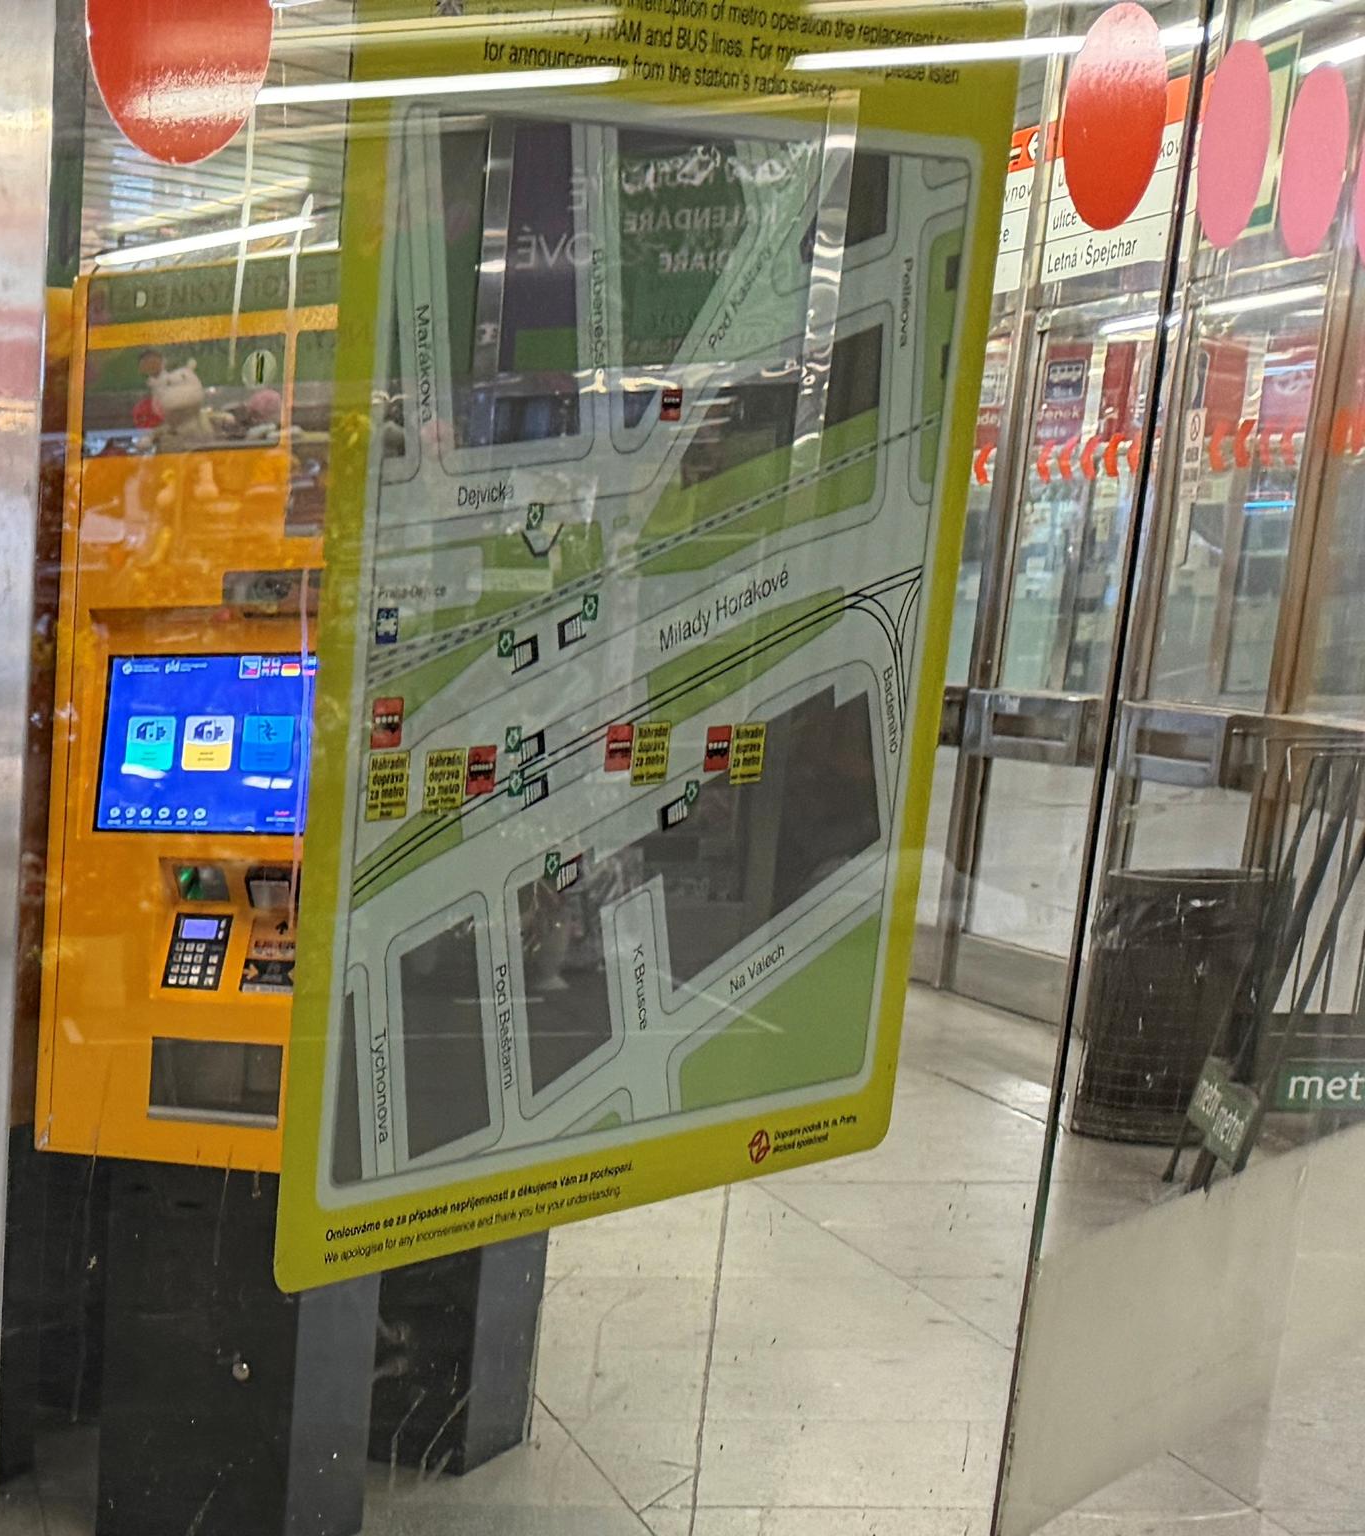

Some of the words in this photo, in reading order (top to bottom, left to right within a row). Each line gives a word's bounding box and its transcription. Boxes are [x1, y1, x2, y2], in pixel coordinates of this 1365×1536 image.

[646, 28, 671, 47] and
[676, 27, 707, 51] BUS
[751, 38, 773, 60] For
[728, 6, 766, 26] metro
[771, 13, 833, 37] operation
[484, 38, 504, 61] for
[632, 54, 665, 80] from
[670, 62, 689, 85] the
[754, 75, 789, 95] radio
[1047, 244, 1077, 275] Letná
[1085, 238, 1138, 266] Špejchar
[659, 606, 711, 653] Milady
[715, 563, 789, 621] Horákové
[632, 943, 645, 962] K
[729, 974, 746, 994] Na
[748, 944, 786, 982] Valech
[494, 963, 510, 1007] Pod
[634, 966, 647, 1032] Brusce
[498, 1011, 513, 1091] Baštami
[373, 1029, 390, 1145] Tychonova
[1195, 1079, 1223, 1118] metr
[324, 1250, 339, 1265] We
[384, 1237, 397, 1251] for
[398, 1234, 414, 1251] any
[476, 1215, 493, 1229] and
[493, 1210, 517, 1227] thank
[535, 1202, 547, 1216] for
[546, 1197, 566, 1216] your
[325, 1221, 382, 1242] Omlouváme
[382, 1218, 394, 1230] se
[396, 1214, 407, 1227] za
[408, 1202, 449, 1226] případné
[450, 1189, 509, 1217] nepříjemnosti
[517, 1179, 558, 1201] děkujeme
[578, 1173, 589, 1186] za
